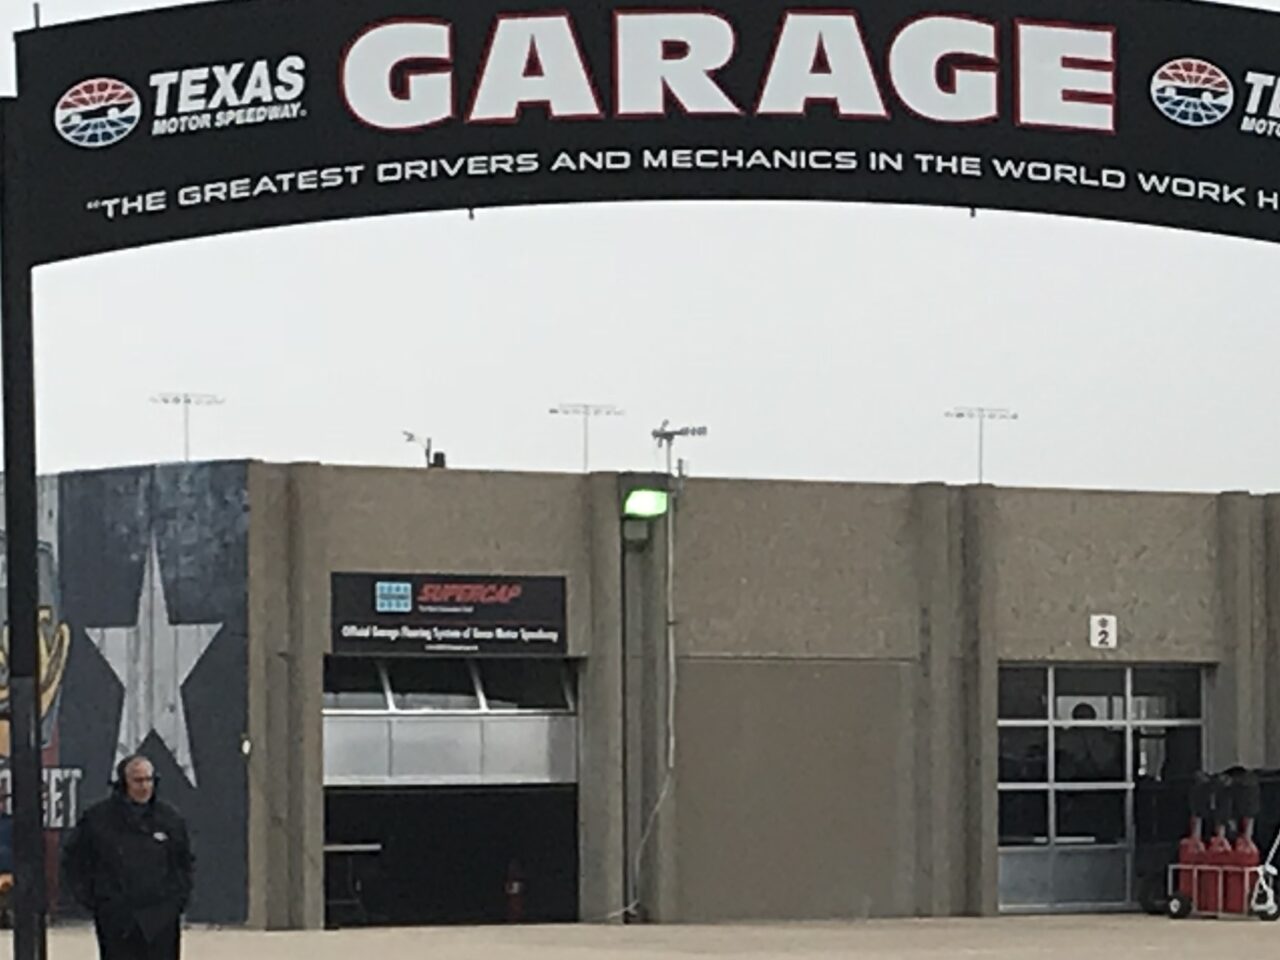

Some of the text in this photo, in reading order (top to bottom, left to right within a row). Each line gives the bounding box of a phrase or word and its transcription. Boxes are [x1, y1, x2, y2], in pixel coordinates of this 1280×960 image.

[150, 55, 305, 116] TEXAS
[341, 7, 1116, 135] GARAGE
[152, 113, 211, 136] MOTOR
[177, 165, 364, 206] GREATEST
[377, 153, 539, 183] DRIVERS
[550, 150, 630, 171] AND
[643, 149, 857, 170] MECHANICS
[869, 151, 903, 171] IN
[914, 153, 982, 176] THE
[992, 158, 1126, 188] WORLD
[1137, 172, 1247, 207] WORK
[415, 583, 522, 604] SUPERCAP
[1098, 629, 1109, 646] 2
